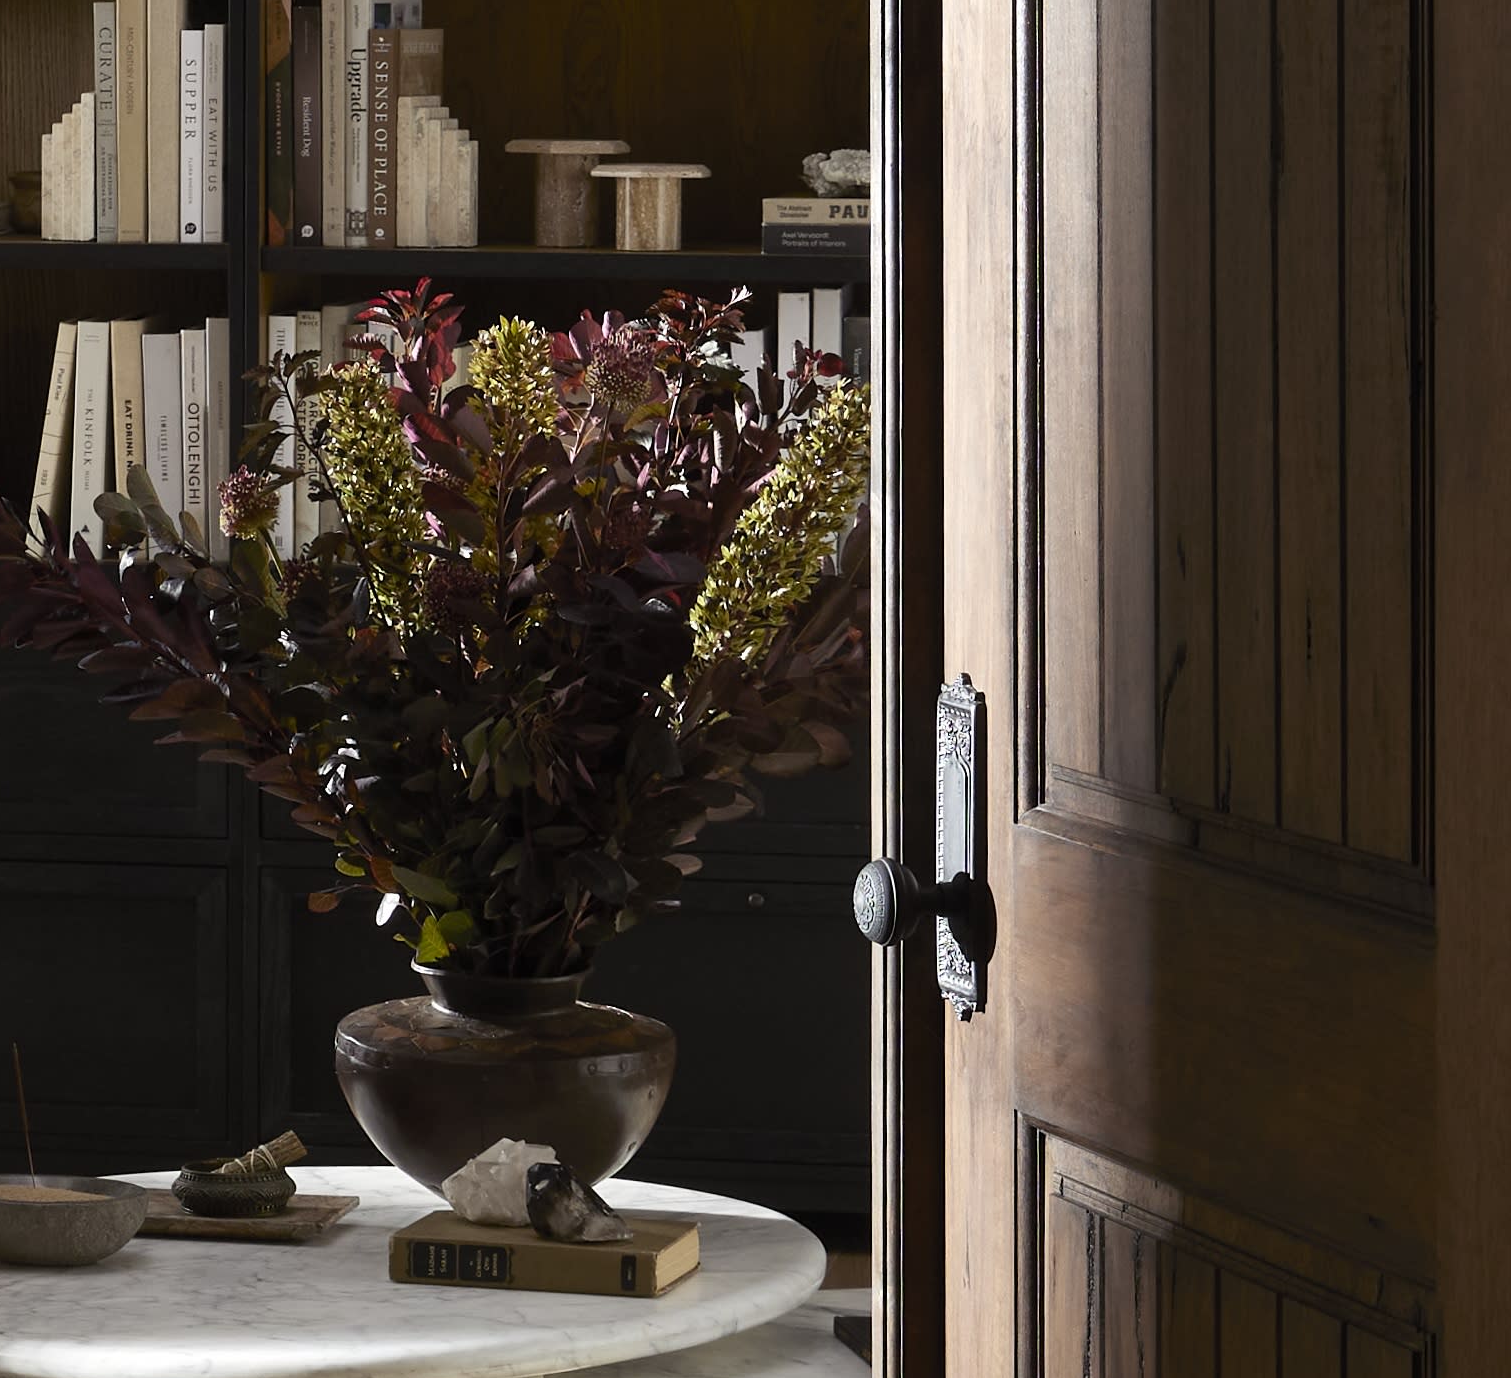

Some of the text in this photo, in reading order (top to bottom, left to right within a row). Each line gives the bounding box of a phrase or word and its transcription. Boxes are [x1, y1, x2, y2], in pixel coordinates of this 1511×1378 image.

[99, 26, 113, 111] CURATE
[125, 26, 135, 115] MID-CENTURY MODERN
[347, 48, 367, 122] Upgrade
[185, 58, 197, 140] SUPPER
[207, 98, 218, 124] EAT
[301, 96, 313, 158] Resident Dog
[207, 130, 218, 168] WITH
[374, 60, 388, 217] SENSE OF PLACE
[207, 174, 218, 193] US
[56, 367, 66, 384] Paul
[83, 407, 94, 466] KINFOLK
[124, 399, 134, 457] EAT DRINK
[159, 414, 169, 482] TIMELESS LIVING
[187, 402, 200, 505] OTTOLENGHI
[427, 1245, 435, 1277] MADAME
[439, 1248, 448, 1273] SARAH
